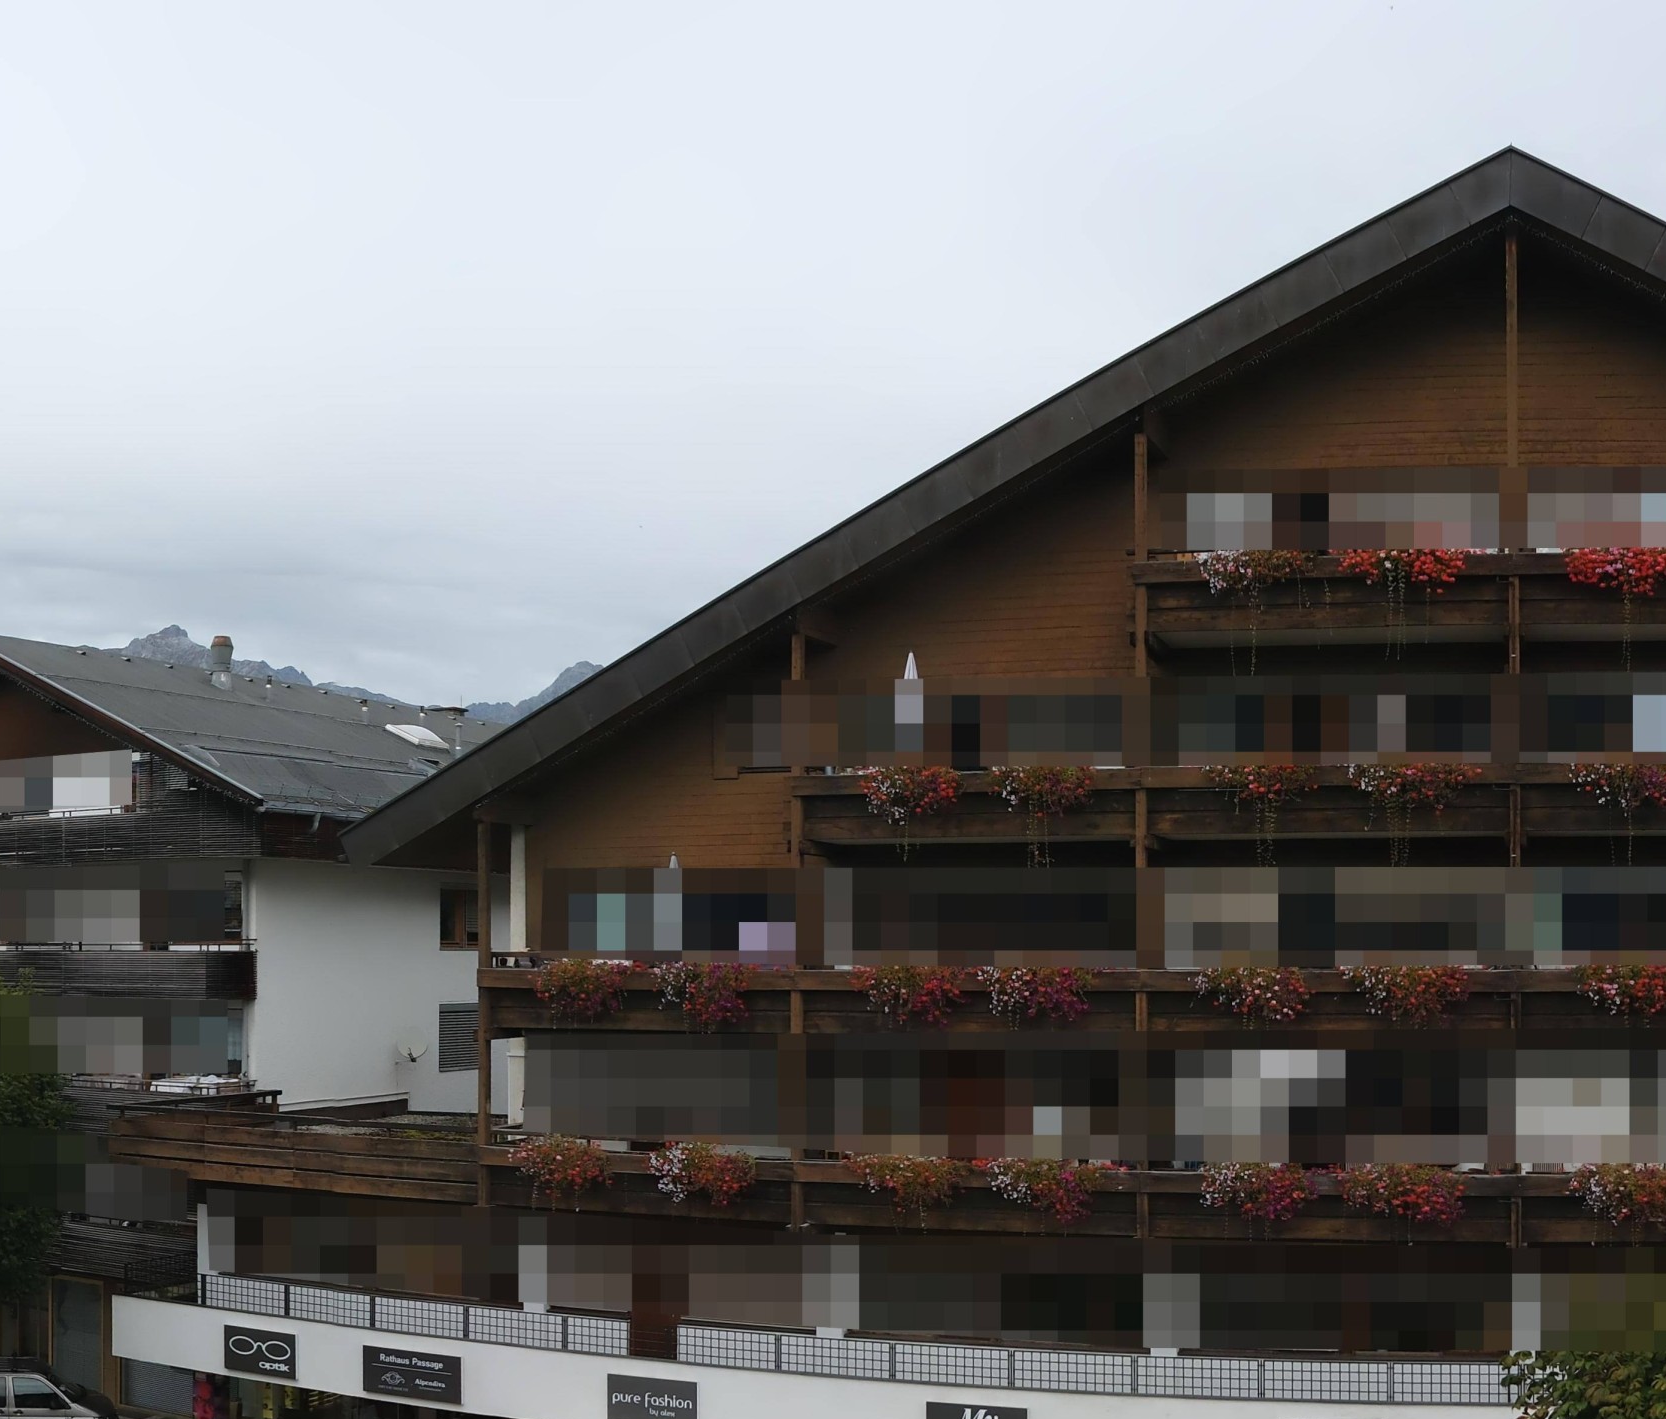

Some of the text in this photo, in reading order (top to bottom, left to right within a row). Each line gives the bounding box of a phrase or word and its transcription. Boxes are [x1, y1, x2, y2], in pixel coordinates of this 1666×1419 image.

[258, 1360, 291, 1374] optik
[379, 1353, 444, 1370] Rathaus Passage
[612, 1392, 693, 1409] pure fashion
[649, 1407, 675, 1418] by alex
